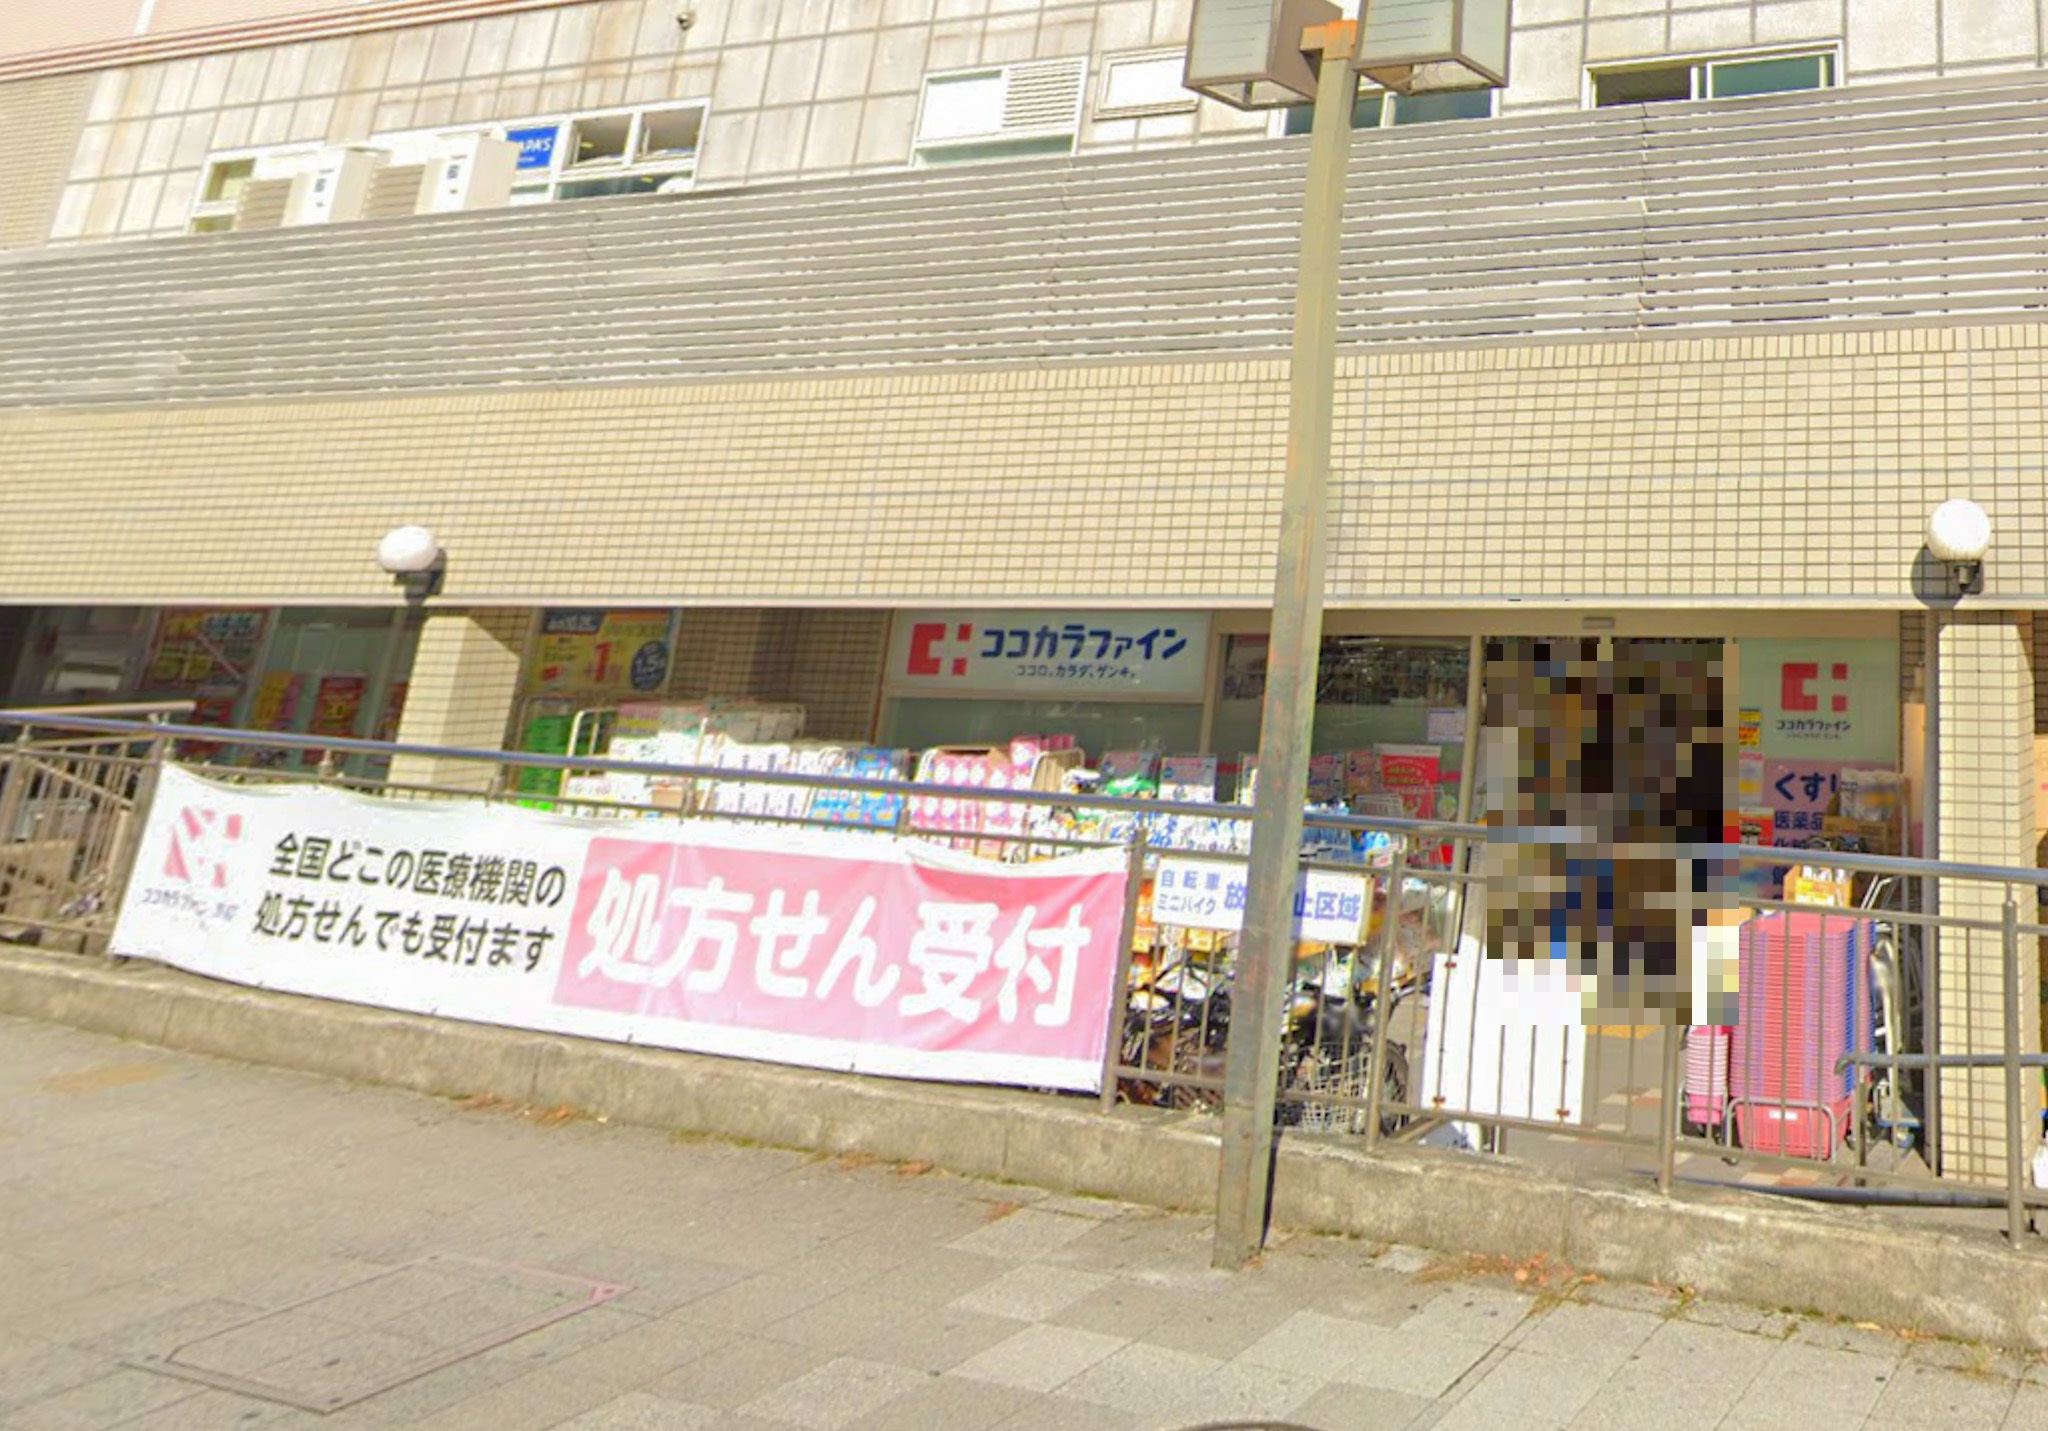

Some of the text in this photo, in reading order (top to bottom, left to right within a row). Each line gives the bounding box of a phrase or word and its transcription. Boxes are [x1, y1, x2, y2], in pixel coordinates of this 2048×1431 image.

[981, 624, 1188, 661] ココカラファイン
[1776, 719, 1852, 732] ココカラファイン
[269, 832, 566, 908] 全国どこの医療機関の
[253, 890, 554, 973] 処方せんでも受付ます
[578, 868, 1092, 1027] 処方せん受付
